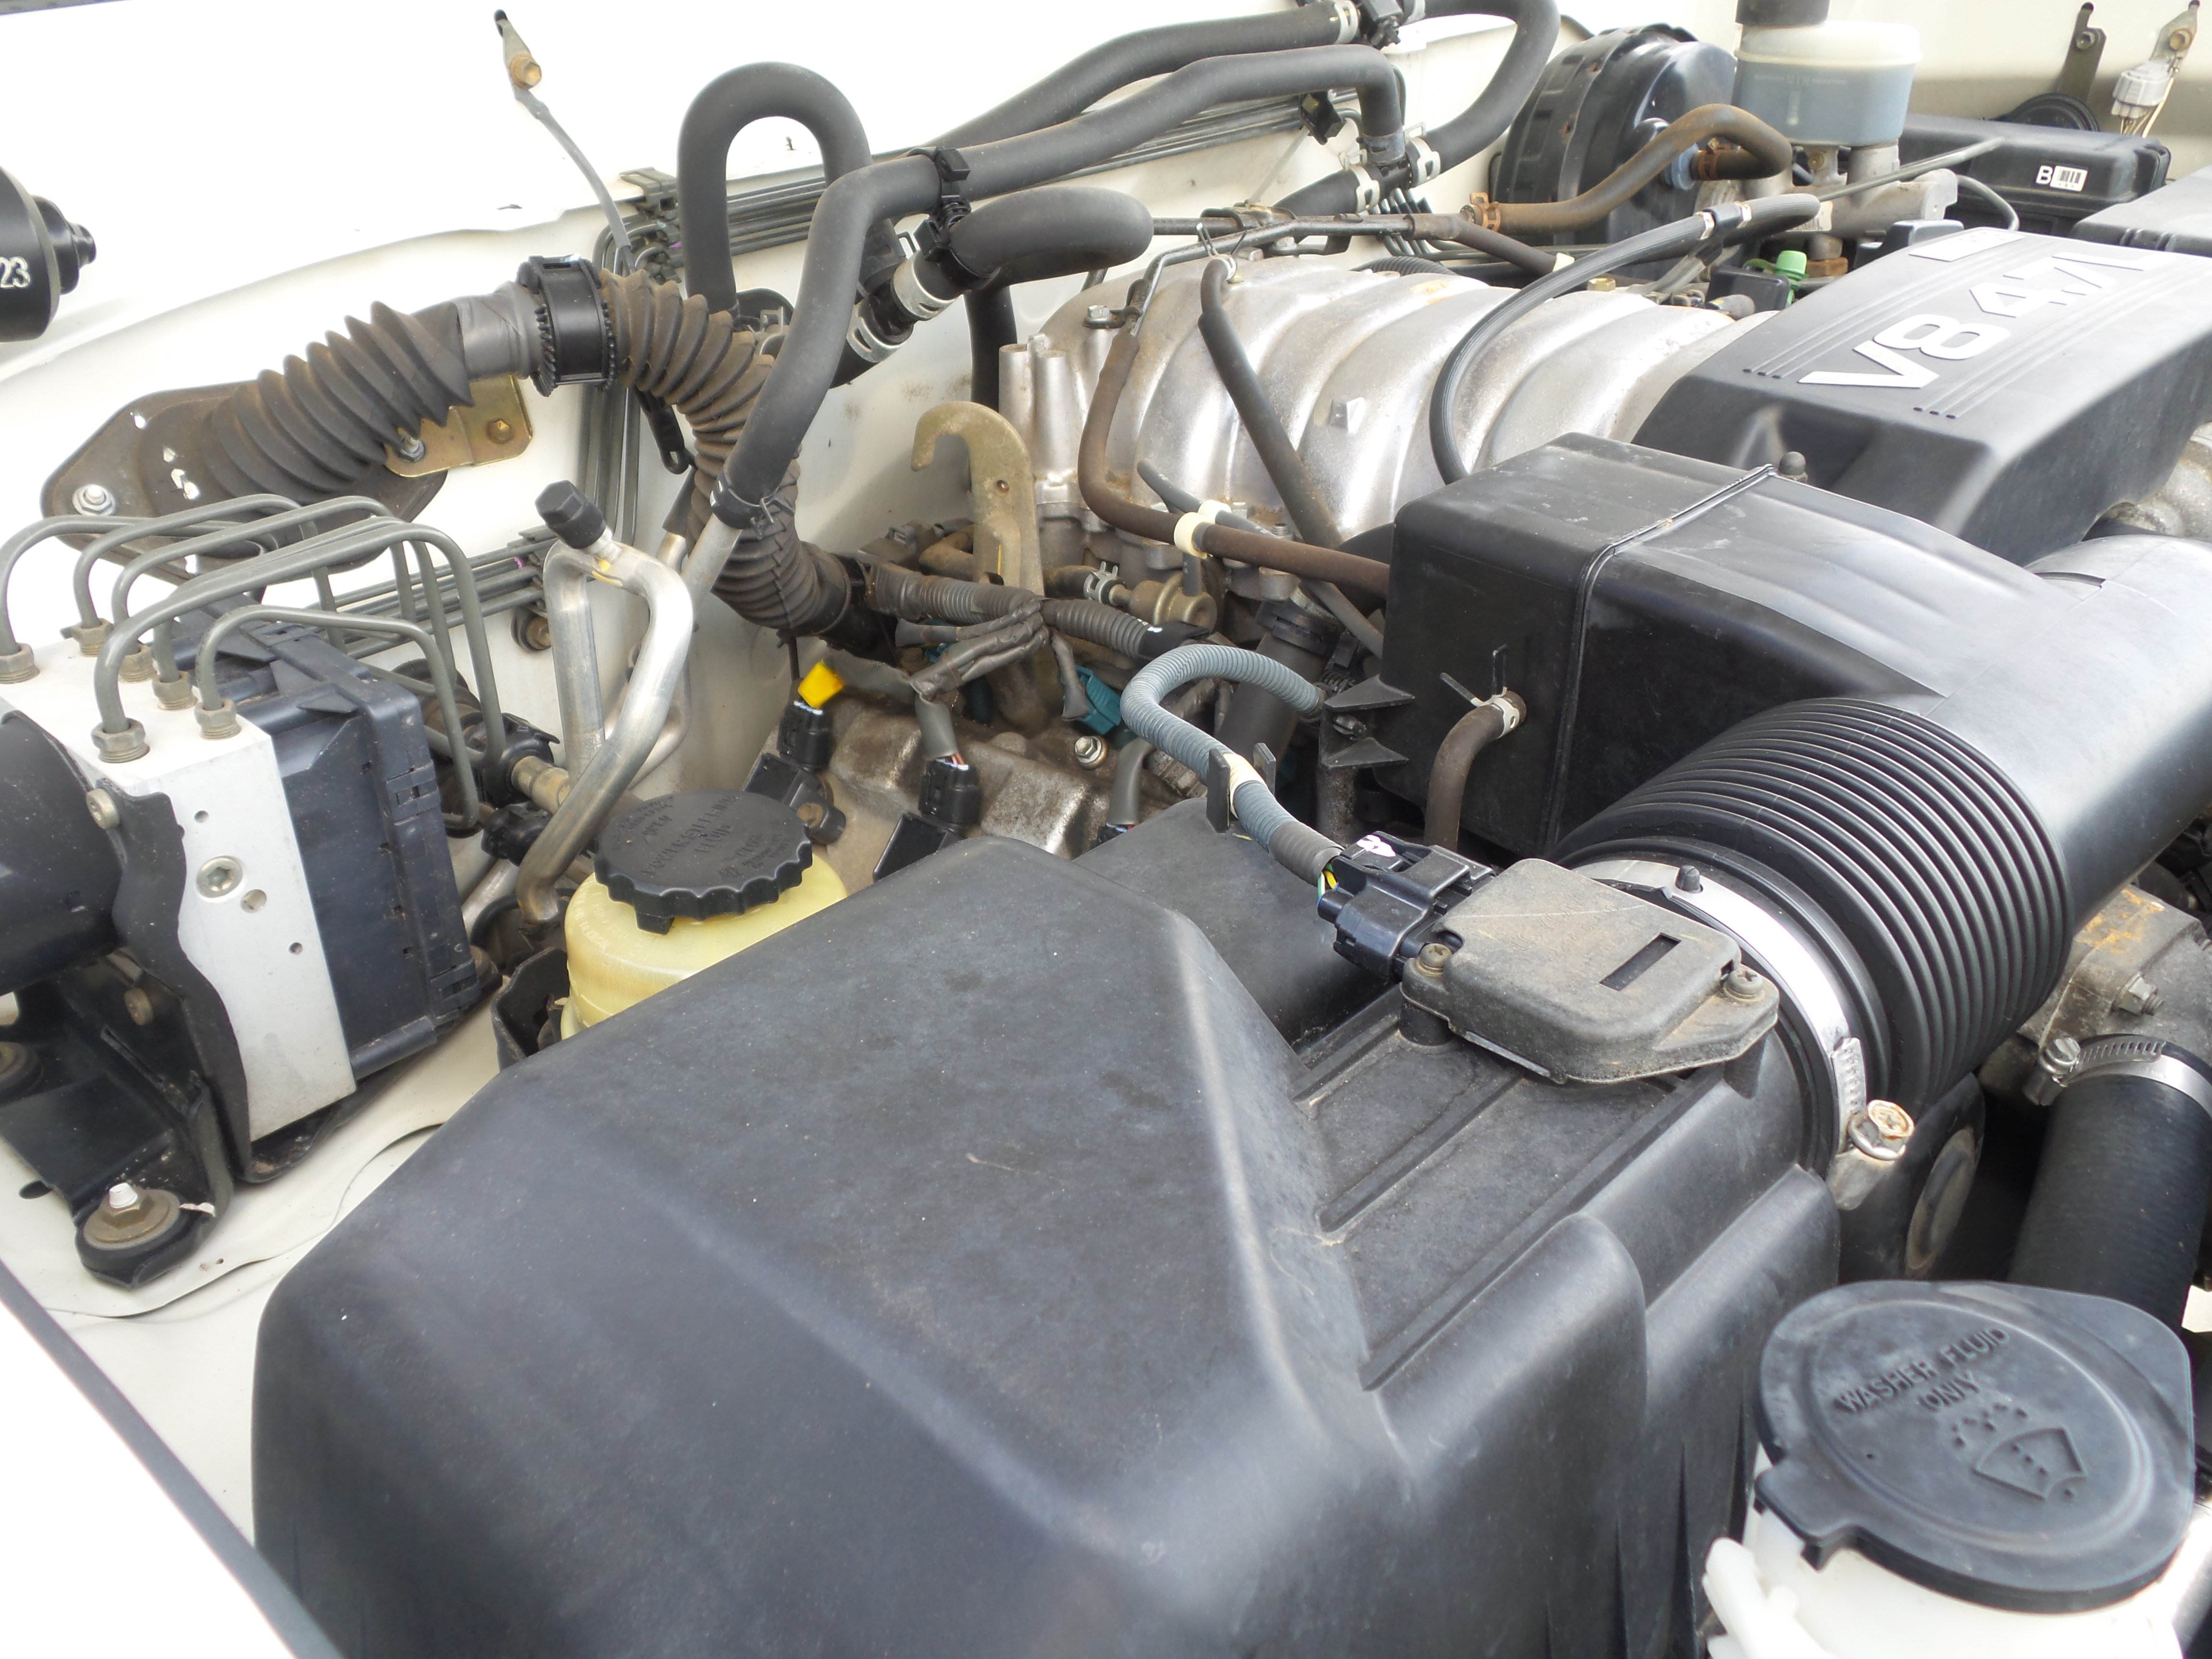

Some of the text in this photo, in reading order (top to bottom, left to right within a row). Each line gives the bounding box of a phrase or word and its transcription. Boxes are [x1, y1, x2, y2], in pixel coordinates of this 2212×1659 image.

[2036, 165, 2053, 184] B
[1798, 314, 2011, 388] V8
[1833, 1328, 2010, 1414] WASHER FLUID
[1920, 1370, 1982, 1412] ONLY
